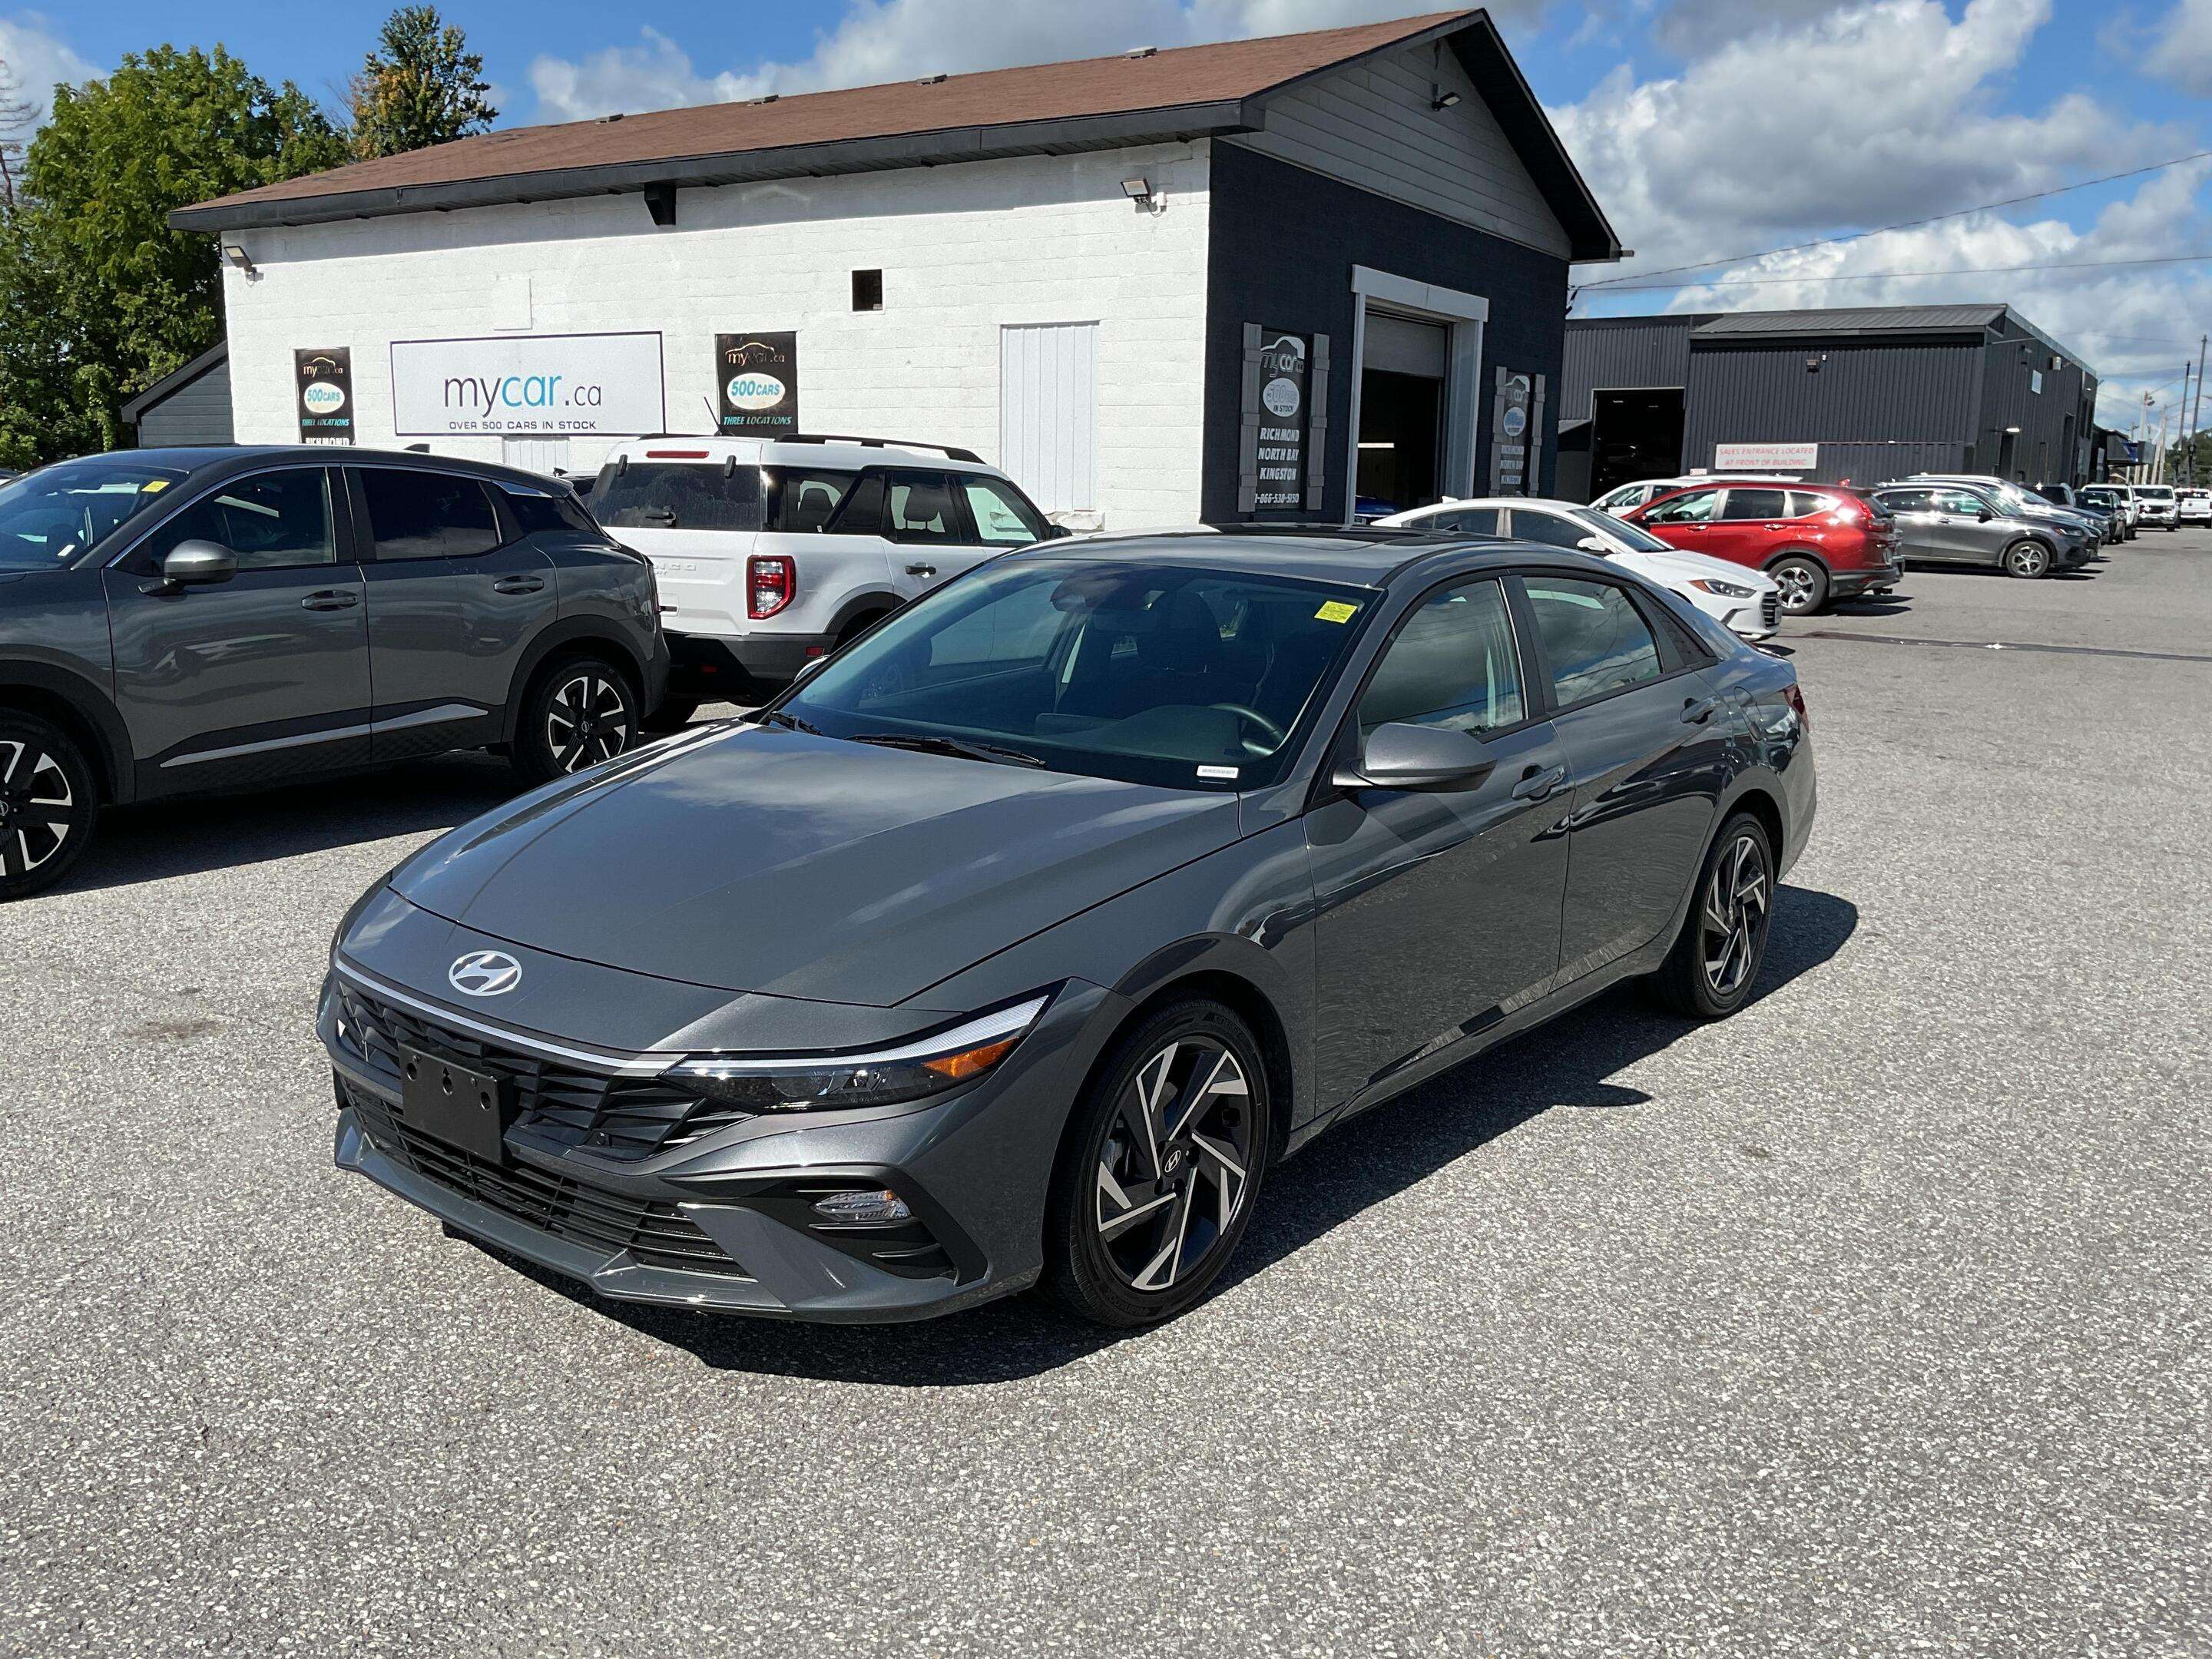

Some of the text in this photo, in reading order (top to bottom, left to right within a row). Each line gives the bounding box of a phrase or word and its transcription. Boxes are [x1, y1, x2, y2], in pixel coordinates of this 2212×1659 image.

[445, 375, 601, 419] mycar.ca
[449, 421, 597, 430] OVER 500 CARS IN STOCK
[724, 416, 792, 426] THREE LOCATIONS
[1260, 427, 1300, 442] RICHMOND
[1257, 447, 1300, 461] NORTH BAY
[1260, 467, 1296, 481] KINGSTON
